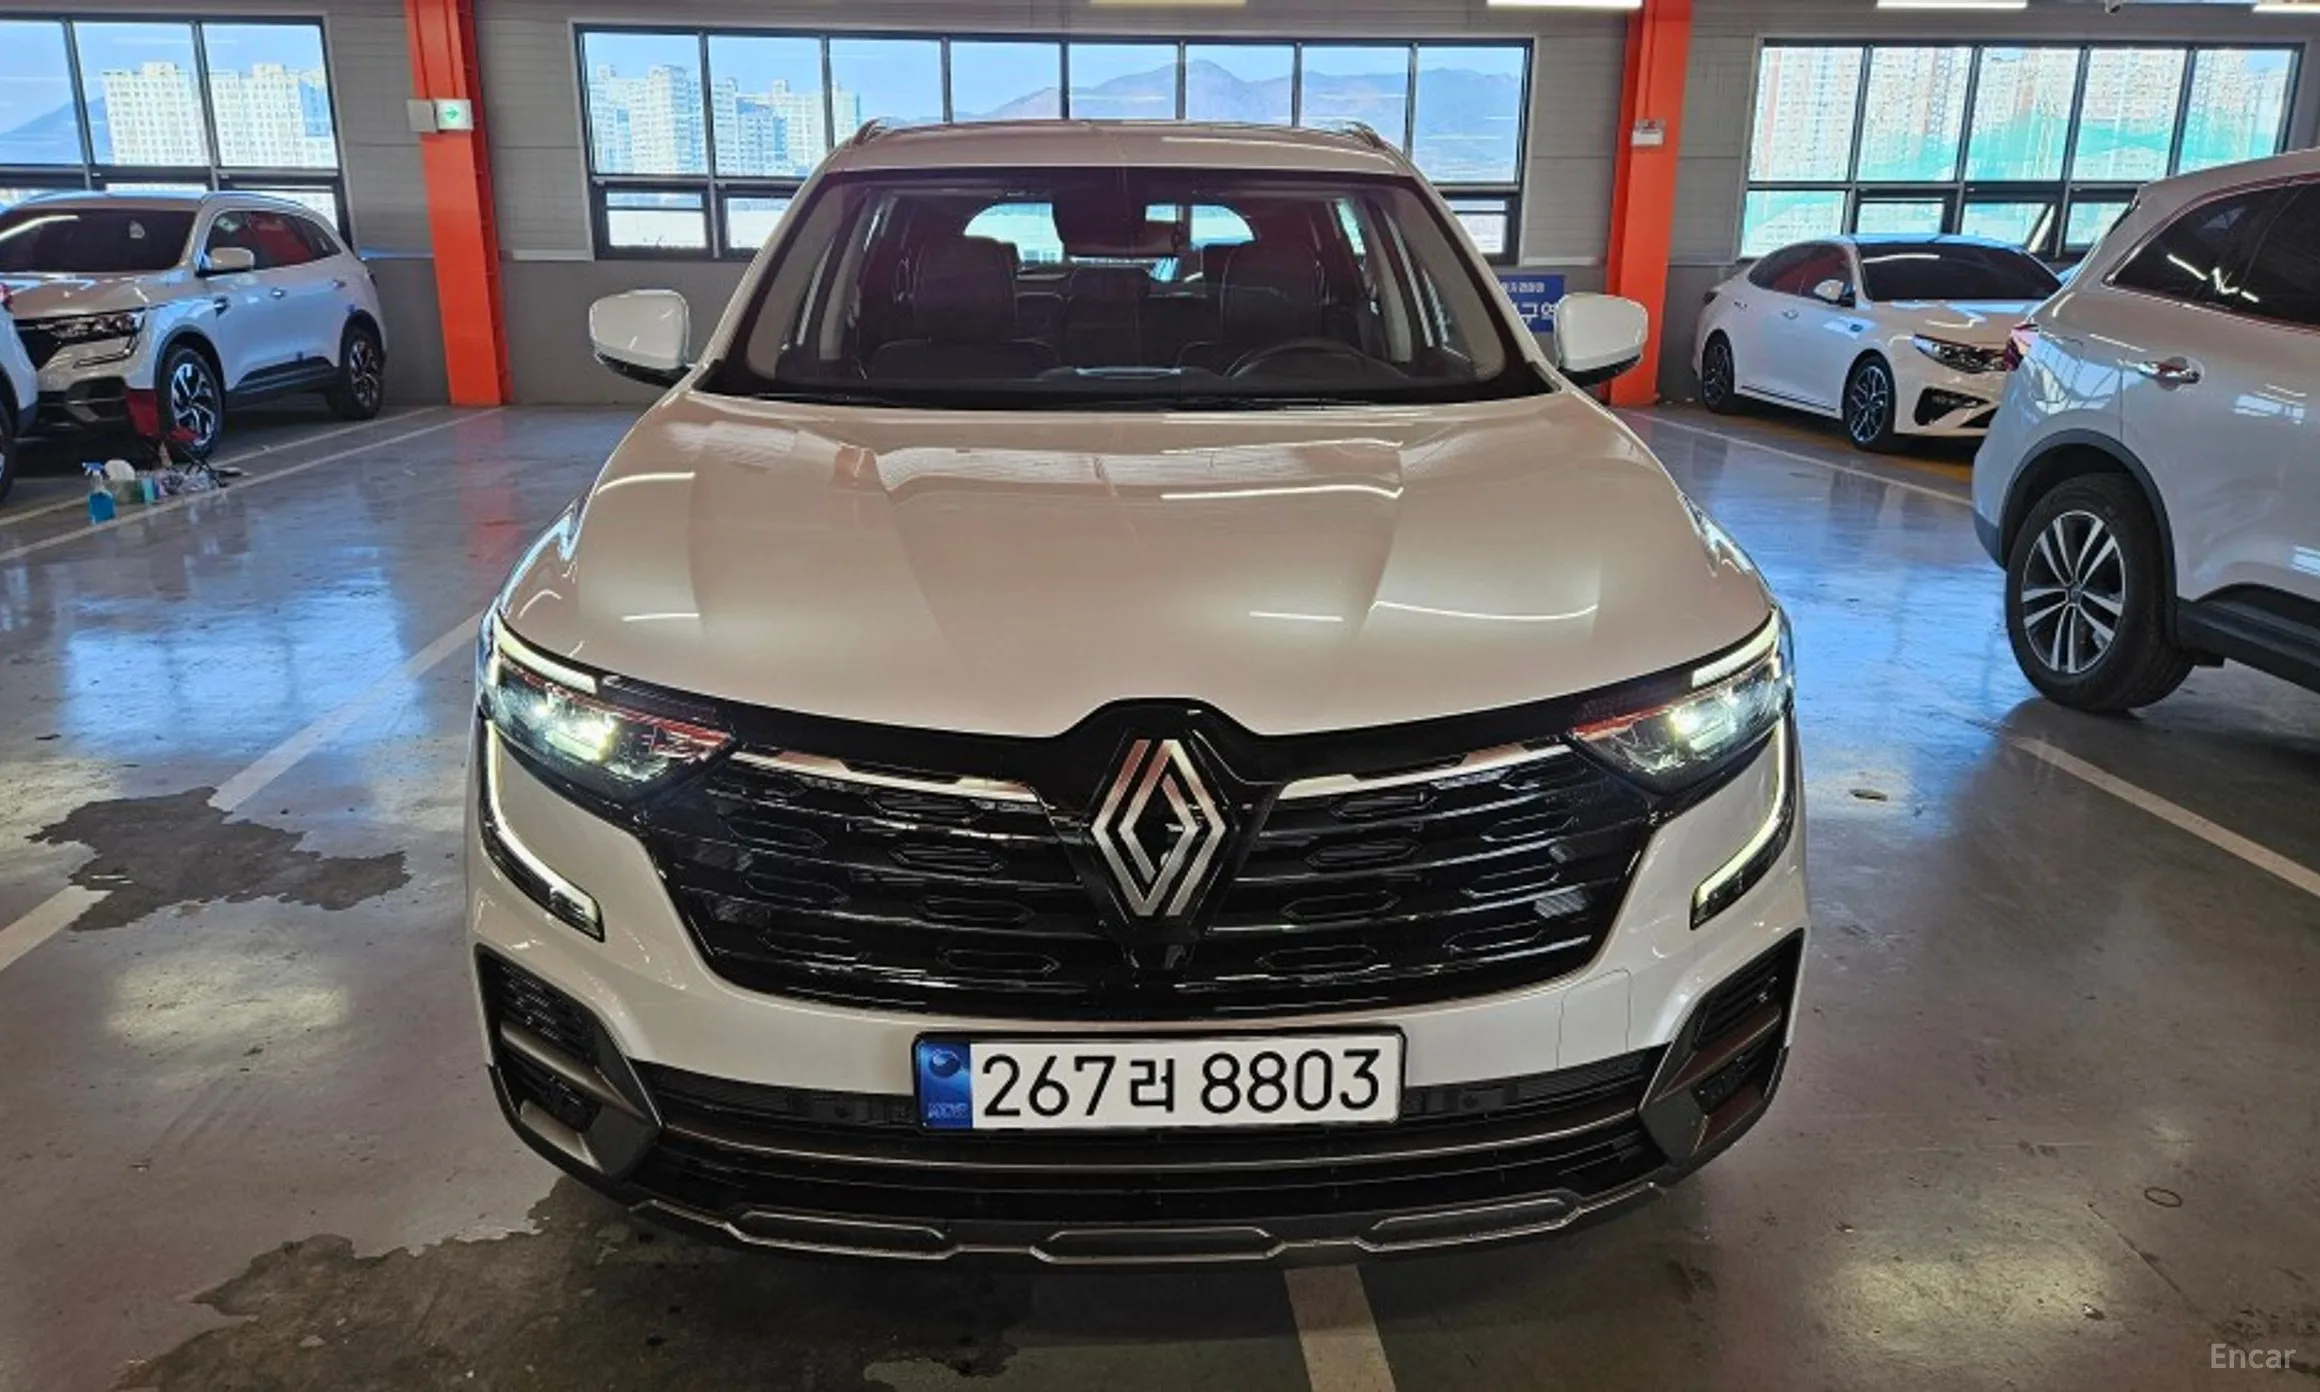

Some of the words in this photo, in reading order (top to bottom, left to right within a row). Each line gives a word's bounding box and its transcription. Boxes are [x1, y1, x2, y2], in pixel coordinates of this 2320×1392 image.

[1512, 301, 1557, 324] 구역
[981, 1054, 1175, 1118] 267러
[1201, 1049, 1381, 1114] 8803
